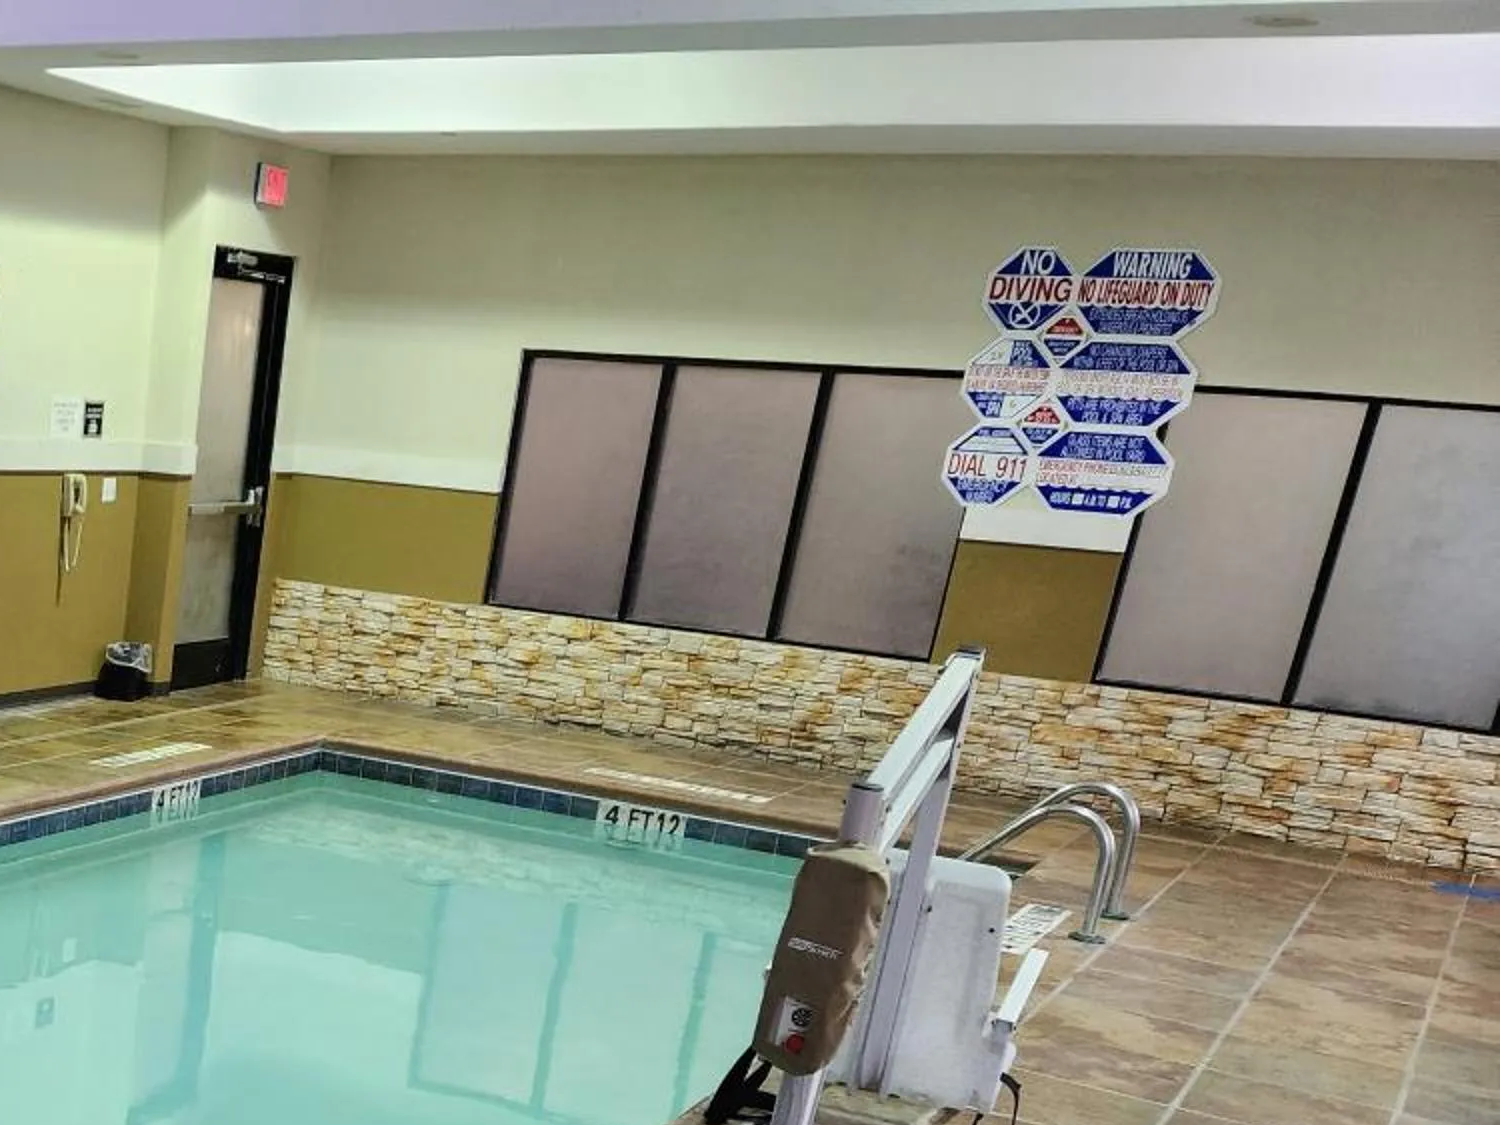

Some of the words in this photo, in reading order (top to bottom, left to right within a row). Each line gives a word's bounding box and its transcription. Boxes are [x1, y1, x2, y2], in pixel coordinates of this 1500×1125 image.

[1019, 250, 1057, 275] NO
[1112, 251, 1193, 278] WARNING
[988, 277, 1074, 302] DIVING
[1077, 279, 1098, 304] NO
[1098, 281, 1160, 306] LIFEGUARD
[1160, 282, 1180, 306] ON
[1180, 283, 1214, 307] DUTY
[948, 453, 986, 477] DIAL
[995, 456, 1028, 482] 911
[605, 806, 620, 824] 4
[627, 808, 654, 831] FT
